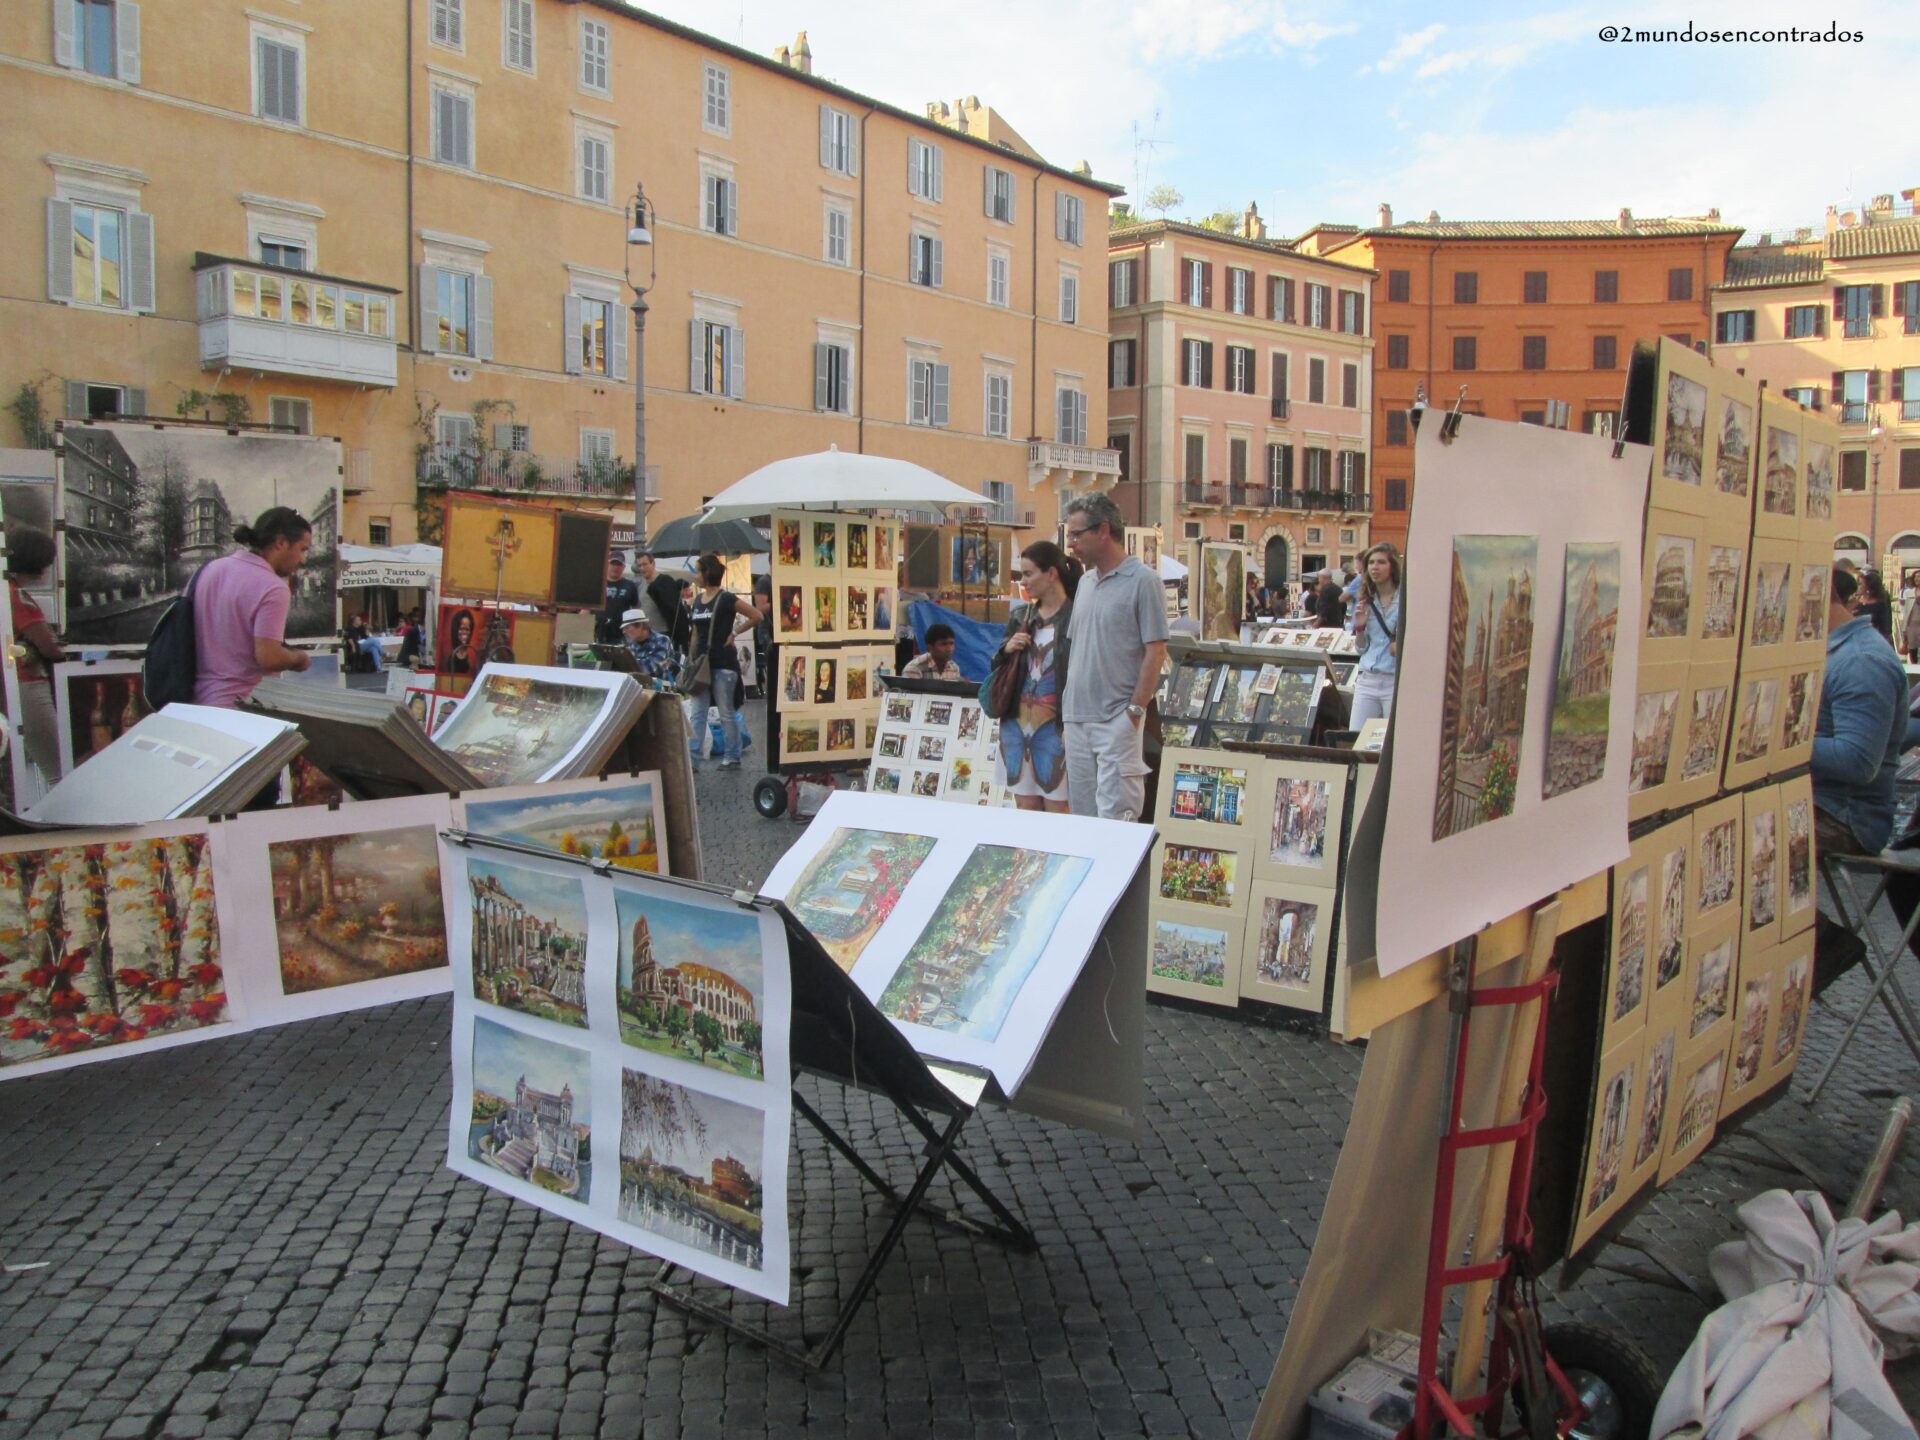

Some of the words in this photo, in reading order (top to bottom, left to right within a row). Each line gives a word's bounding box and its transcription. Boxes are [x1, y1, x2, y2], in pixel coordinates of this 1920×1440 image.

[342, 569, 378, 577] Cream
[385, 568, 426, 577] Tartufo
[342, 577, 380, 586] Drinks
